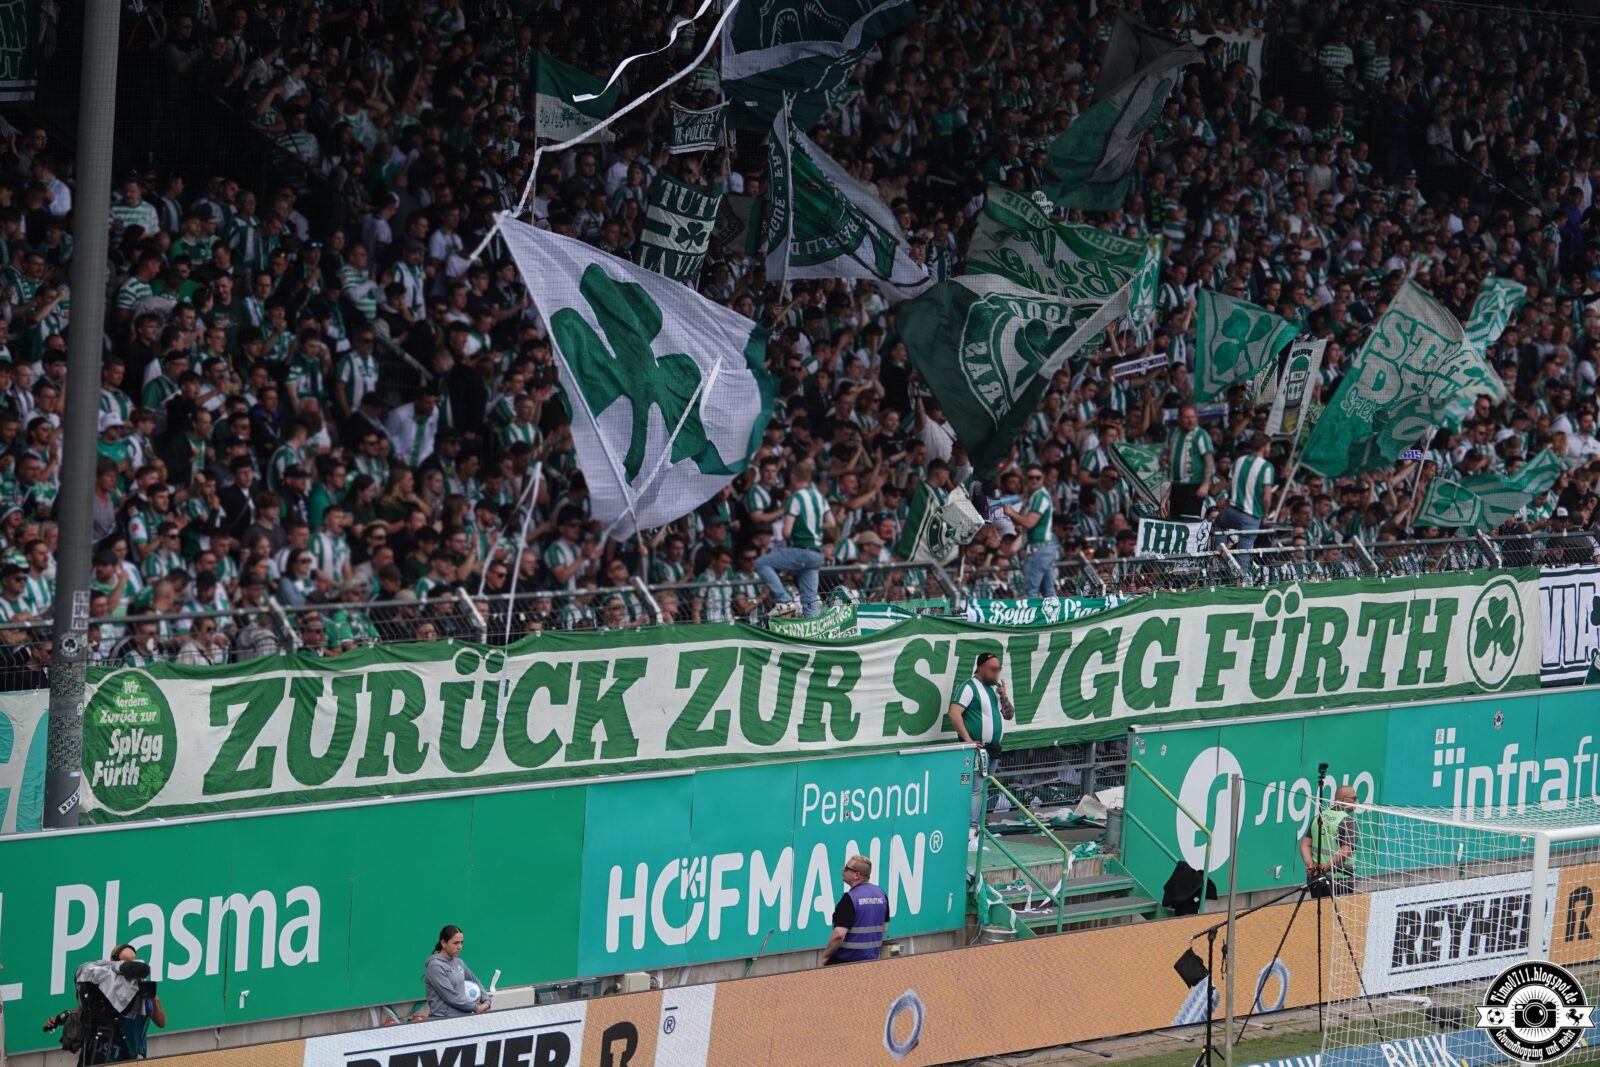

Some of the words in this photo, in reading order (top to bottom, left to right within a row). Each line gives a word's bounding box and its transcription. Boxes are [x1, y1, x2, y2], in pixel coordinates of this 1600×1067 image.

[1141, 521, 1190, 554] IHR
[202, 648, 650, 796] ZURÜCK
[666, 646, 863, 751] ZUR
[1196, 589, 1459, 701] FÜRTH
[108, 728, 164, 763] SpVgg
[91, 758, 141, 788] Fürth
[802, 770, 930, 827] Personal
[50, 879, 321, 996] Plasma
